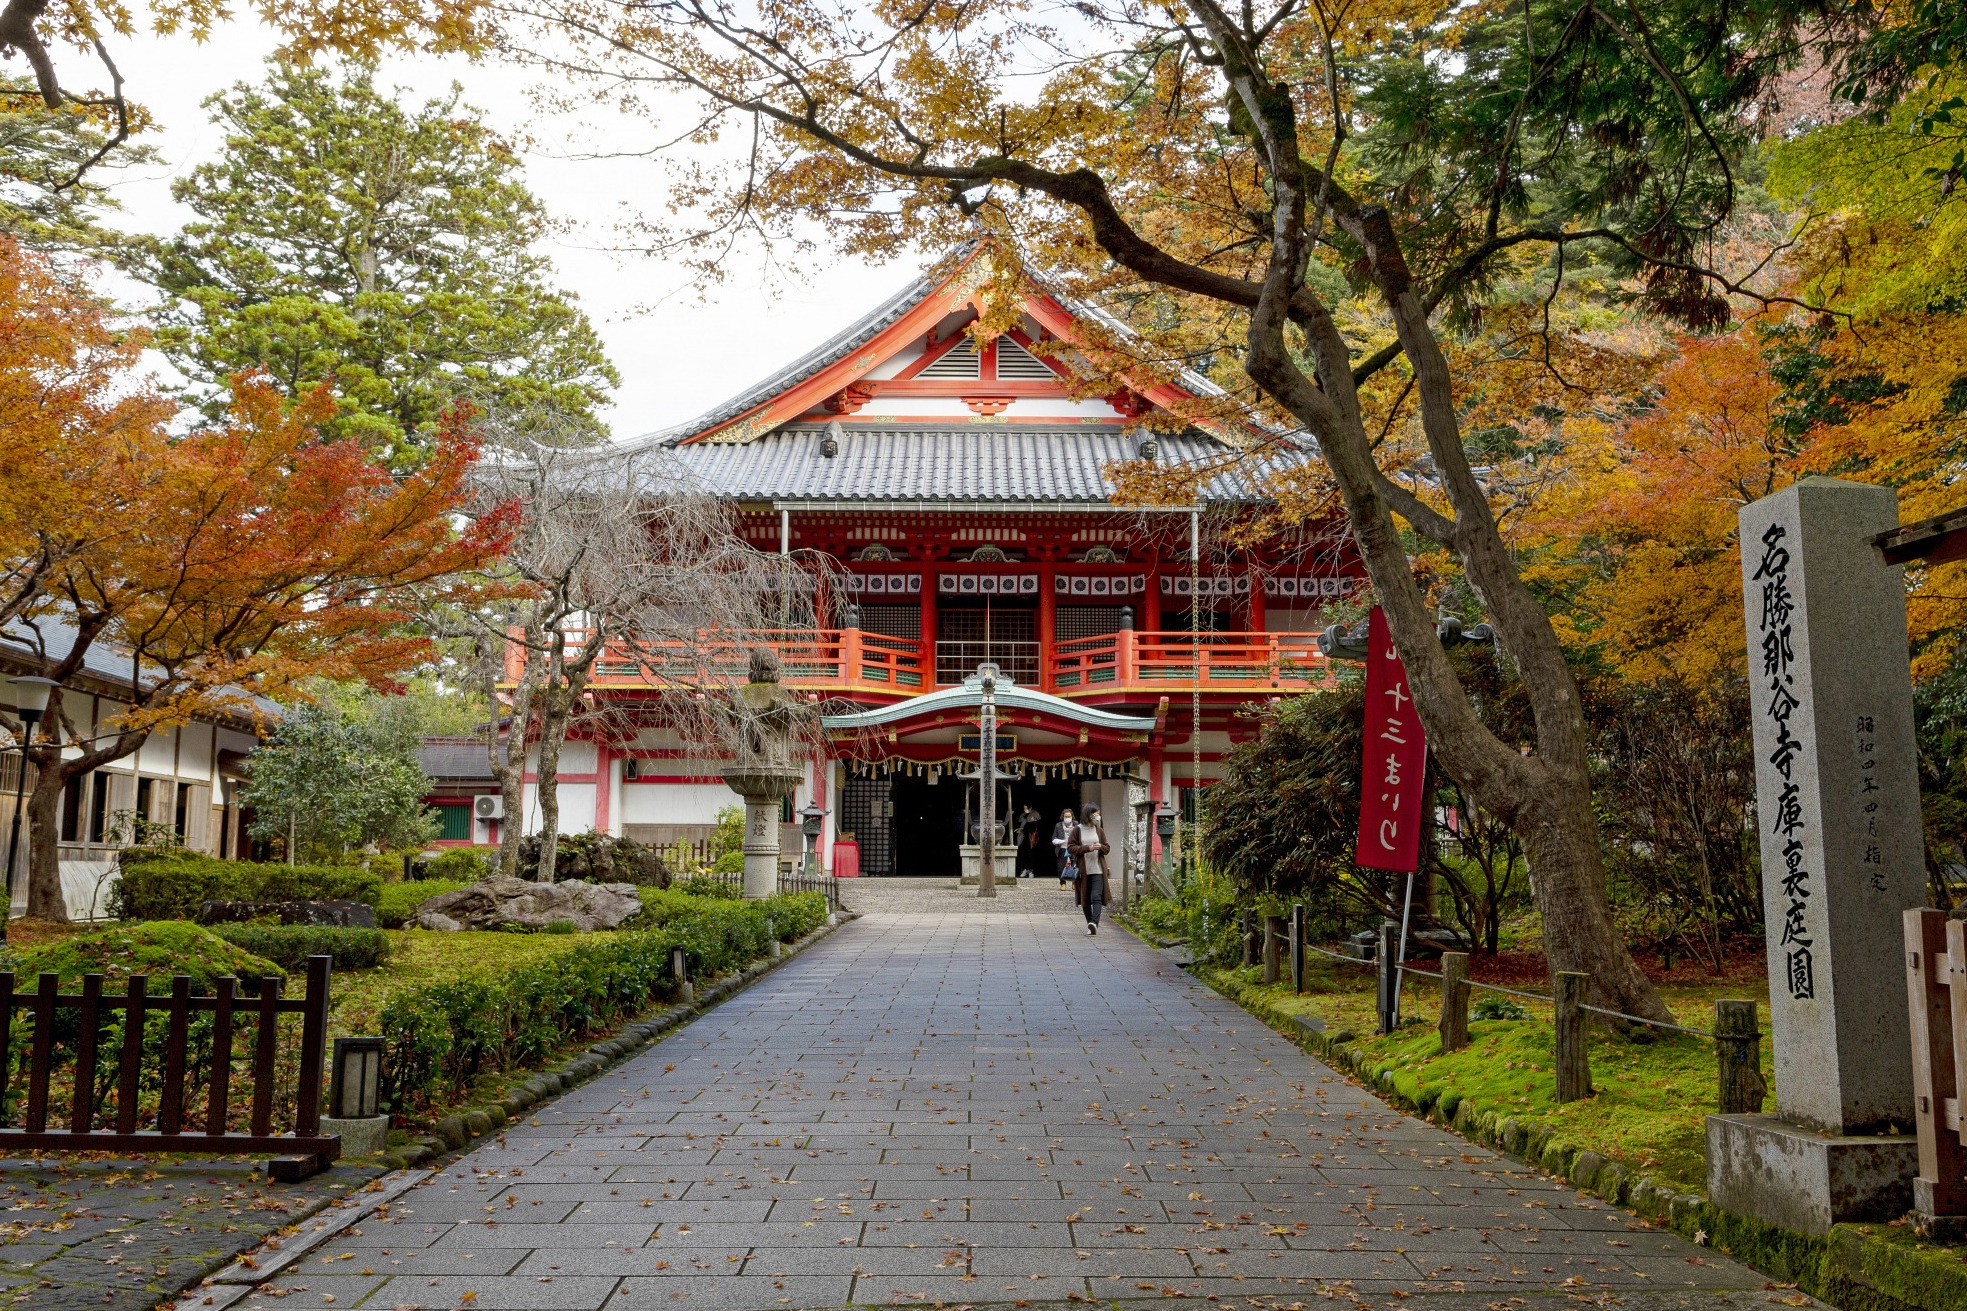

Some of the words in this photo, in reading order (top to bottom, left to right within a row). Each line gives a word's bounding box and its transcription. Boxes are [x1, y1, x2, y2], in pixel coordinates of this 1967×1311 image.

[1752, 522, 1814, 999] 名勝那谷寺庫裏庭園
[1856, 715, 1887, 892] 昭和四年四月指定
